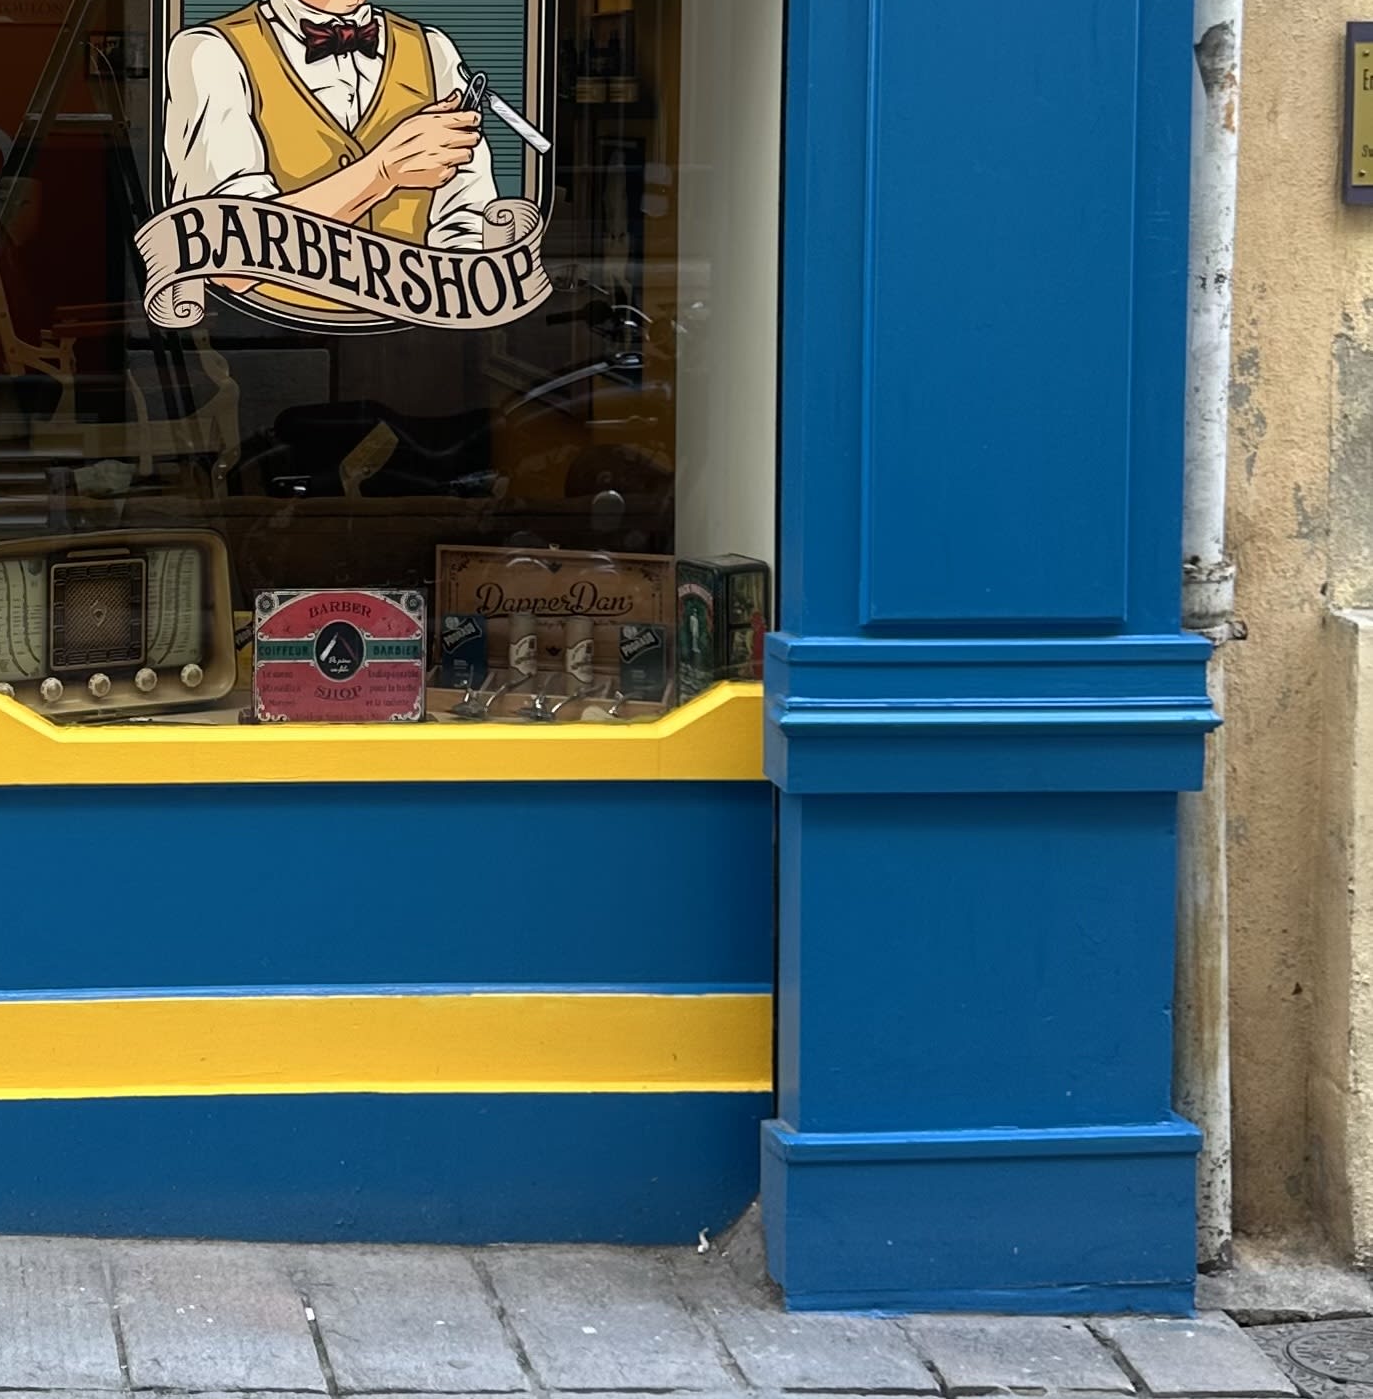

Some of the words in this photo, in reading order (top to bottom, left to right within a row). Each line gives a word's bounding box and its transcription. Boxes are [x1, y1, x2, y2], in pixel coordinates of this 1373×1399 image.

[170, 204, 534, 319] BARBERSHOP
[476, 581, 572, 616] Dapper
[570, 580, 634, 616] Dan
[308, 600, 372, 619] BARBER
[258, 644, 311, 657] COIFFEUR
[373, 644, 419, 657] BARBIER
[314, 685, 363, 700] SHOP
